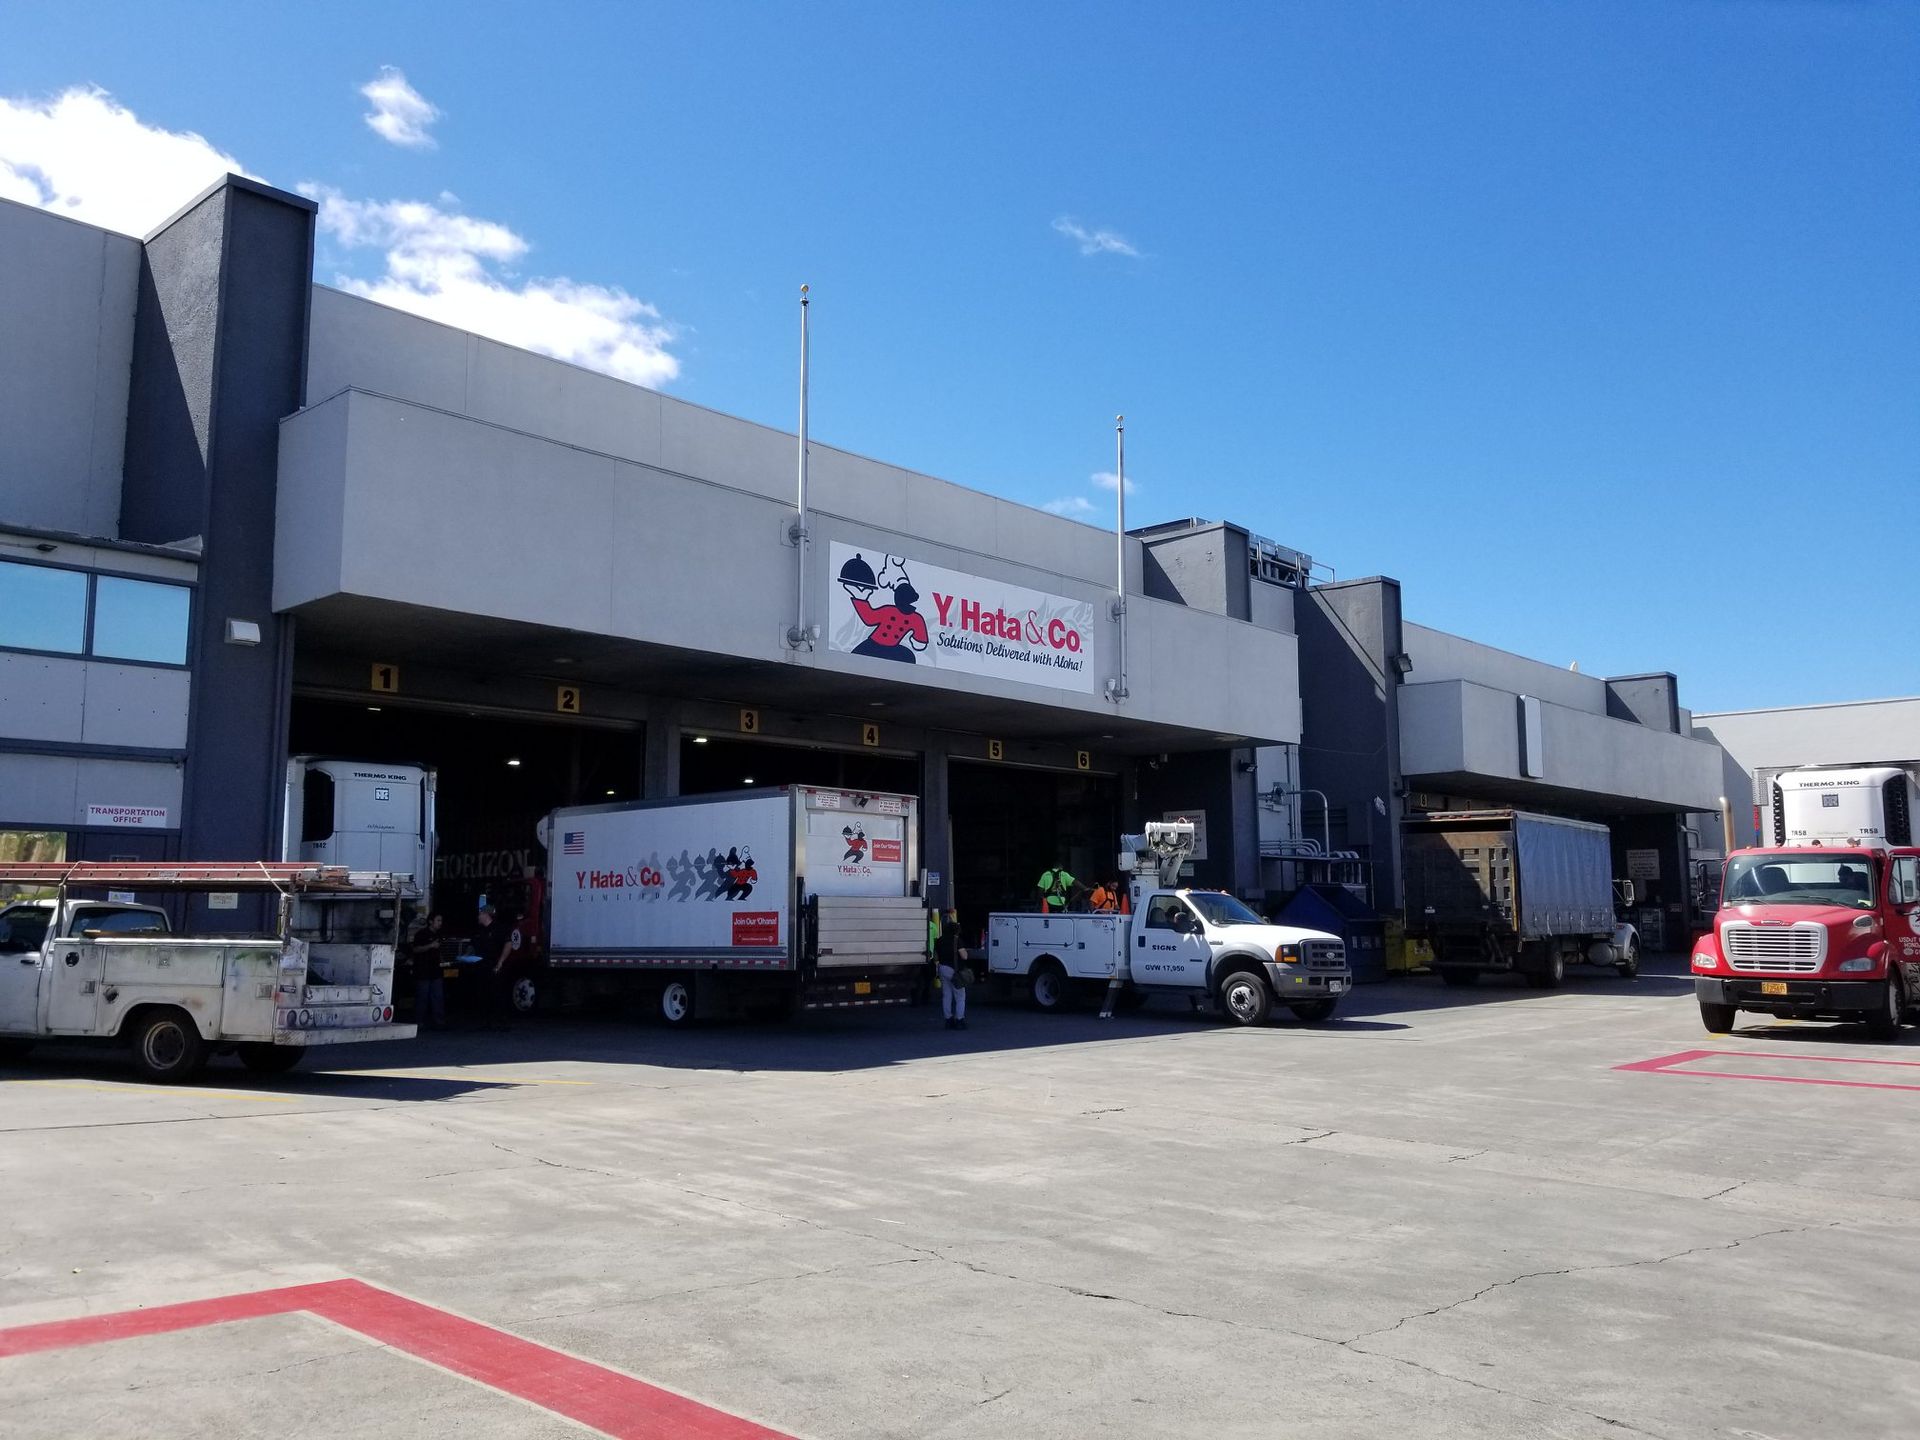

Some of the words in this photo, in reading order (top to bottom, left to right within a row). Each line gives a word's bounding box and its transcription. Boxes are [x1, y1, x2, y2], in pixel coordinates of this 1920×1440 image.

[932, 592, 953, 627] Y.
[961, 599, 1021, 641] Hata
[1025, 610, 1047, 646] &
[1048, 619, 1083, 653] Co.
[937, 632, 983, 653] Solutions
[986, 642, 1030, 662] Delivered
[1032, 652, 1051, 666] with
[1053, 655, 1083, 672] Aloha!
[379, 667, 391, 689] 1
[562, 690, 574, 709] 2
[744, 711, 754, 730] 3
[866, 727, 875, 743] 4
[992, 742, 1000, 757] 5
[1079, 753, 1087, 767] 6
[90, 807, 166, 817] TRANSPORTATION
[576, 871, 587, 889] Y.
[590, 870, 624, 888] Hata
[625, 866, 639, 887] &
